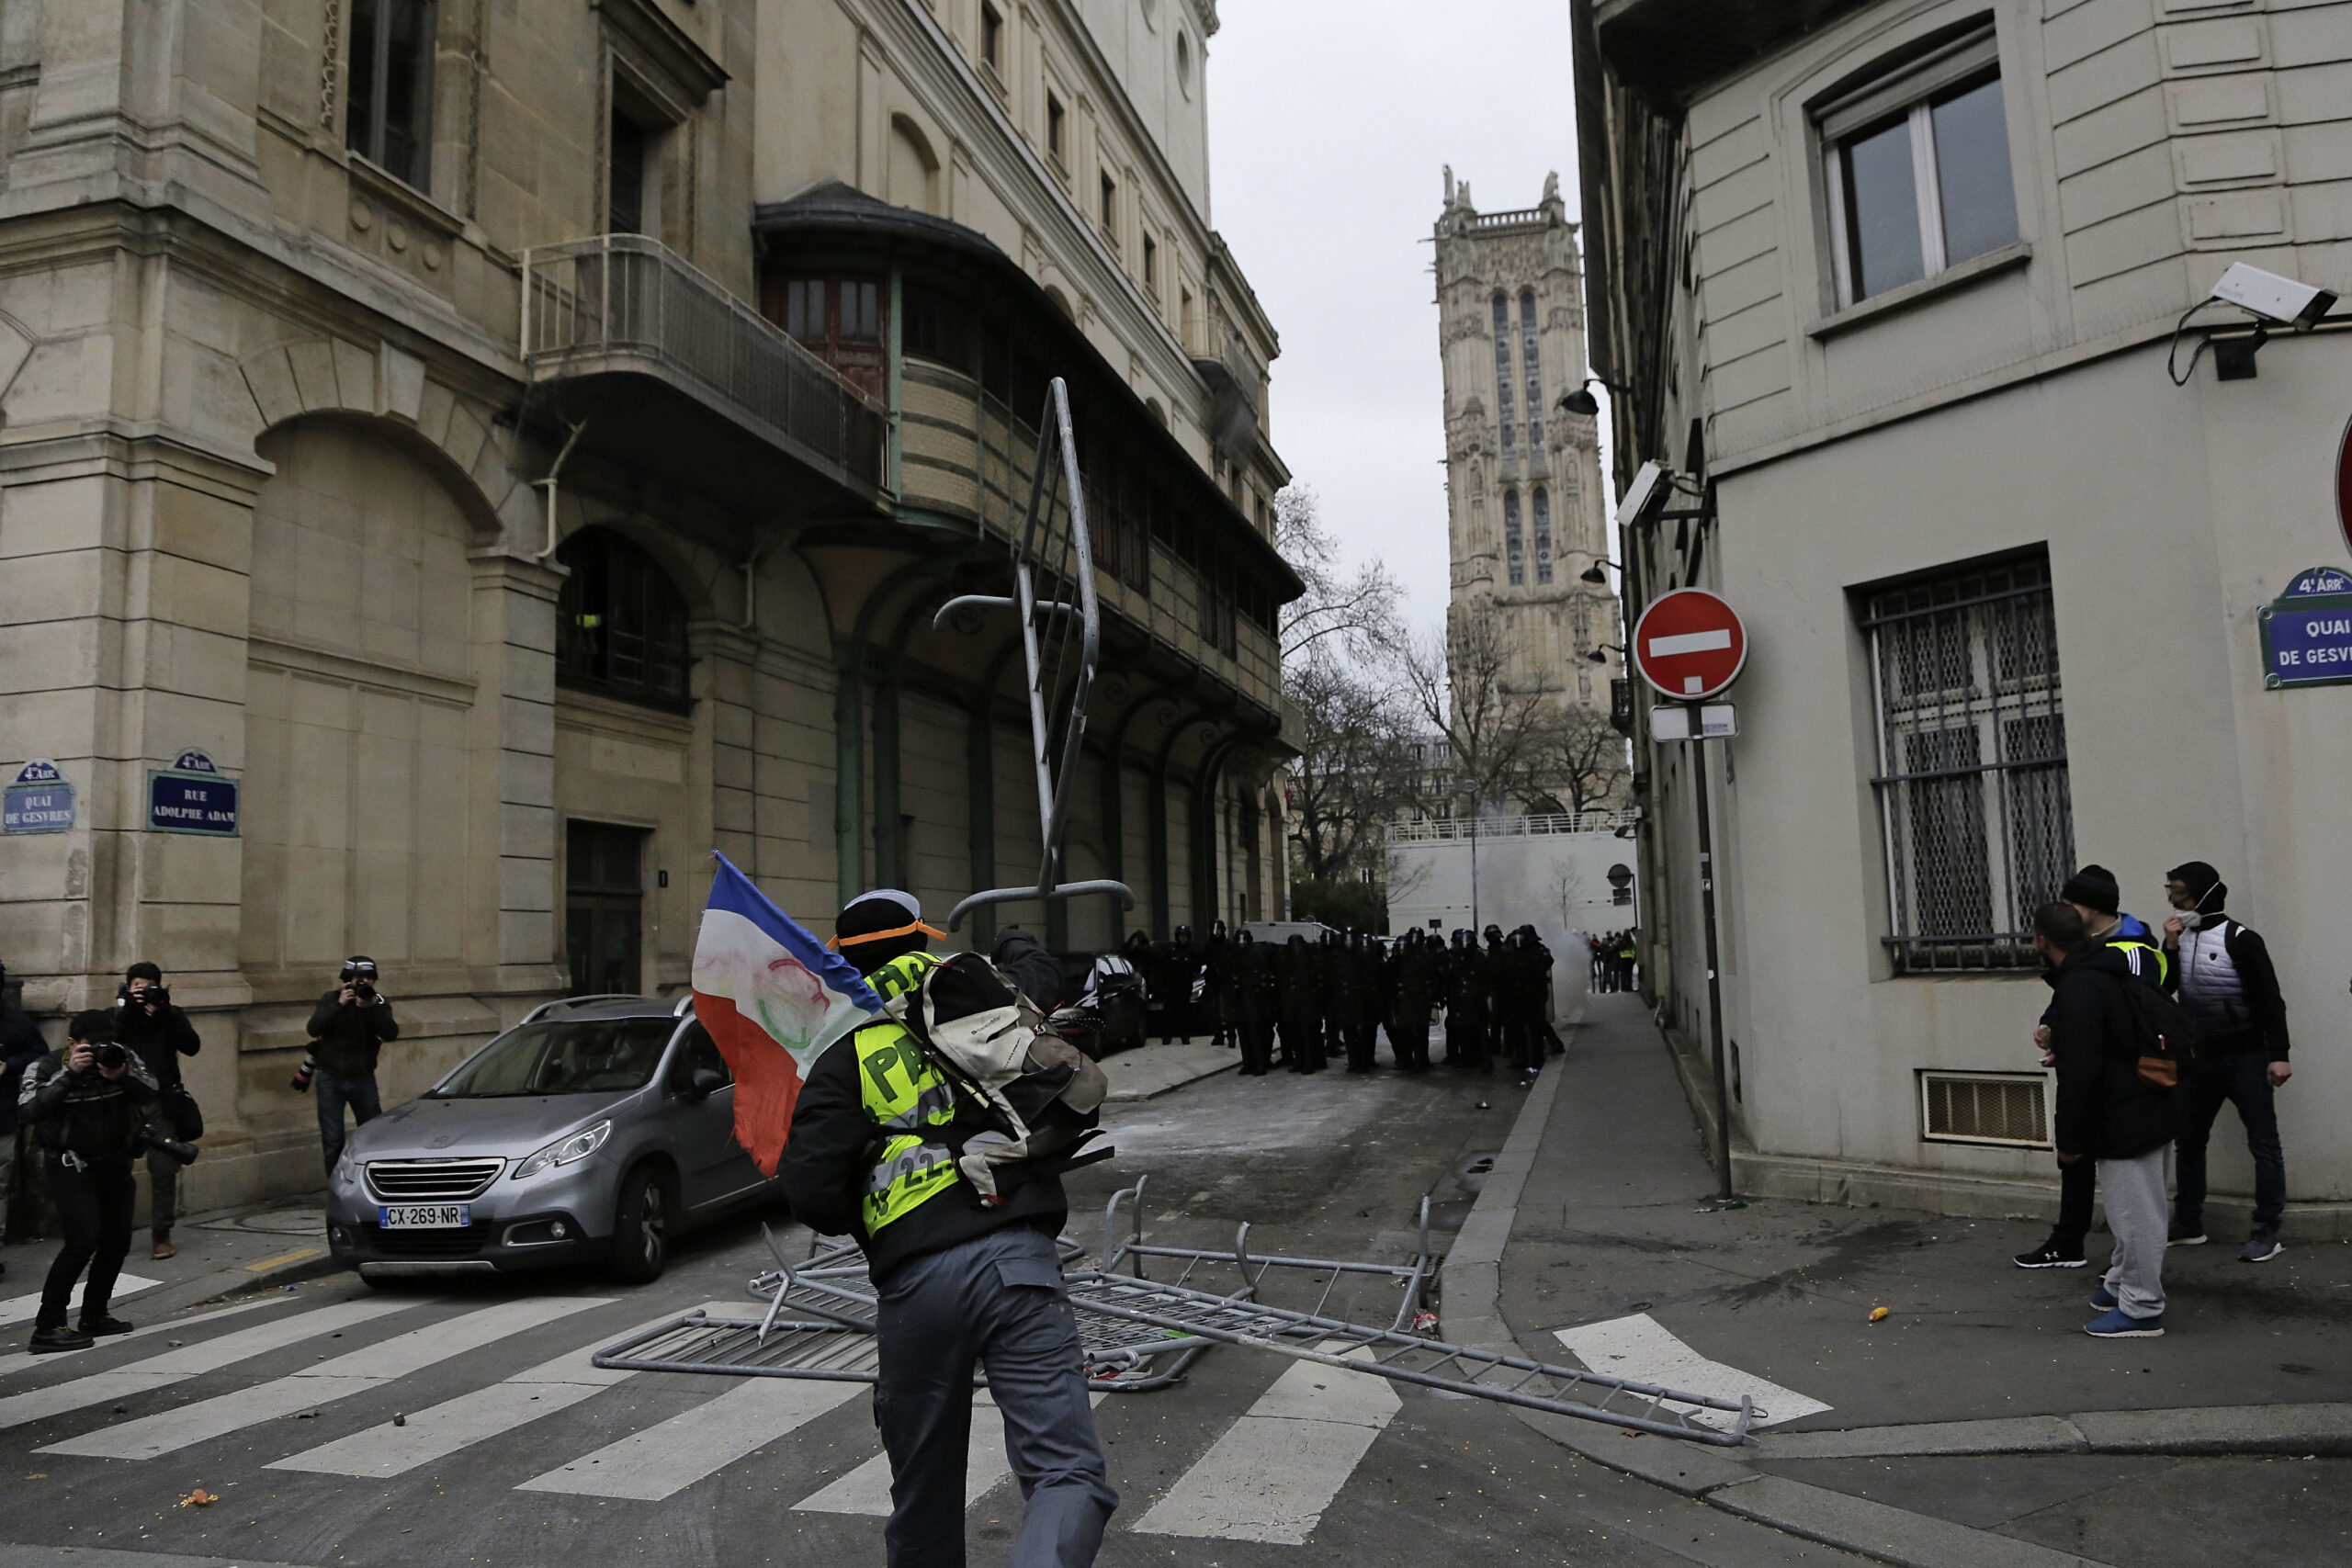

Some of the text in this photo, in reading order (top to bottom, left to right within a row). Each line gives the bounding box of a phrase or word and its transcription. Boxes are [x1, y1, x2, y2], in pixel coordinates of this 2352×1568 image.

[2306, 619, 2350, 637] QUAI
[2278, 647, 2352, 666] DE GESV
[26, 795, 52, 810] QUAI
[184, 789, 208, 802] RUE
[5, 810, 70, 824] DE GESVRES
[153, 805, 234, 822] ADOLPHE ADAM
[389, 1207, 458, 1224] CX-269-NR
